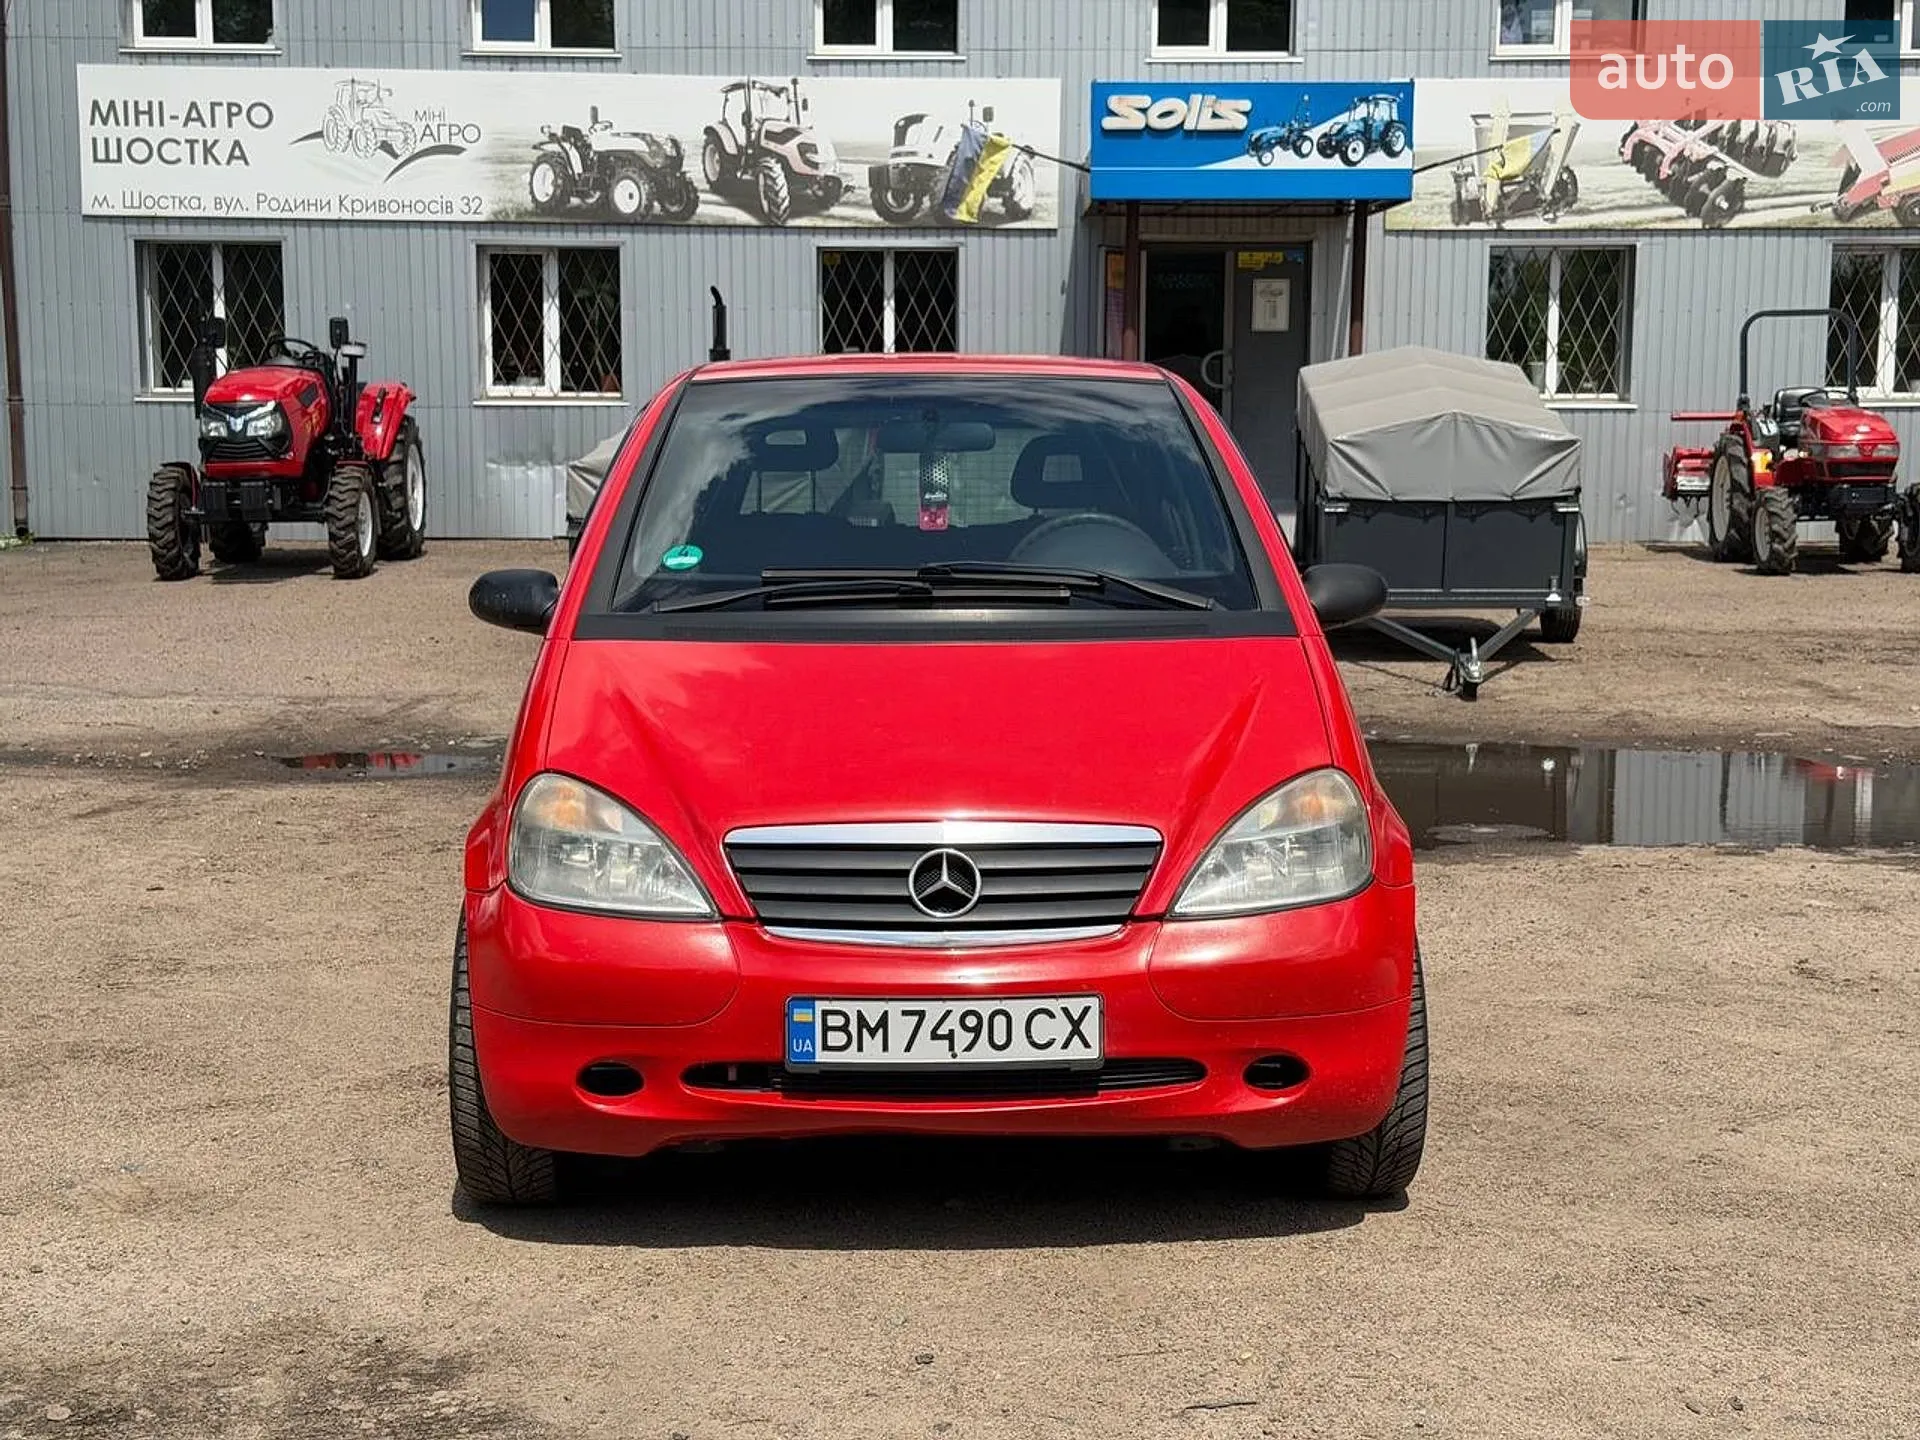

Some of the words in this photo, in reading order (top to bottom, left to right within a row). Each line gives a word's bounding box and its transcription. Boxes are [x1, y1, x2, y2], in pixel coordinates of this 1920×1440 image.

[89, 99, 274, 129] МІНІ-АГРО
[419, 123, 482, 144] АГРО
[91, 136, 250, 166] ШОСТКА
[91, 194, 116, 210] м.
[122, 190, 207, 212] Шостка,
[213, 195, 250, 215] вул.
[256, 192, 332, 215] Родини
[338, 194, 454, 217] Кривоносів
[460, 195, 484, 216] 32
[821, 1008, 889, 1053] BM
[900, 1007, 1013, 1053] 7490
[1024, 1004, 1092, 1051] CX
[793, 1038, 814, 1053] UA
